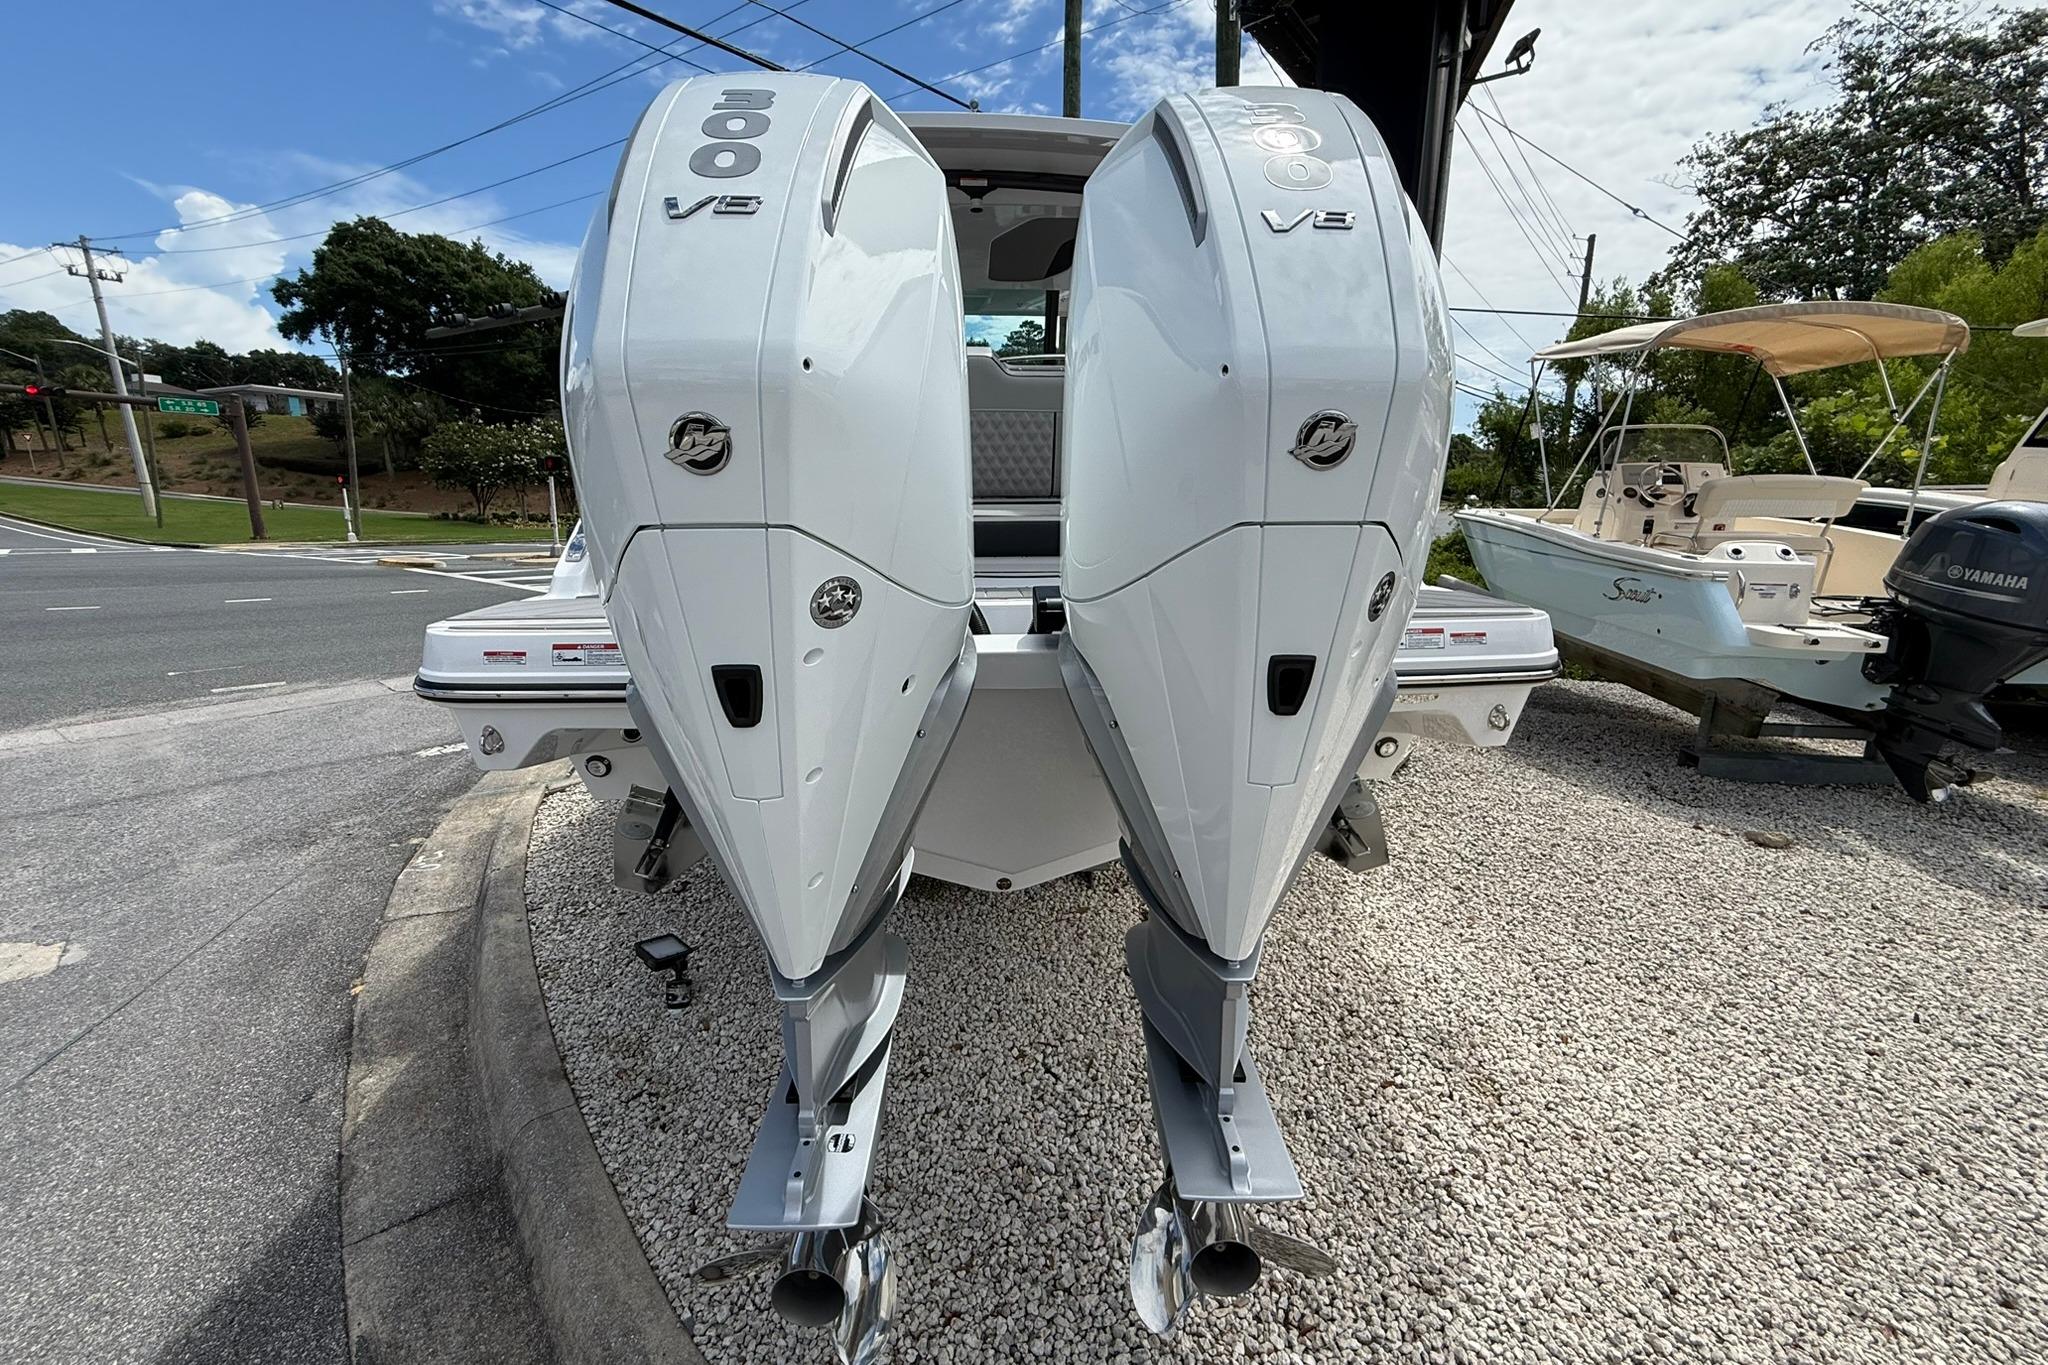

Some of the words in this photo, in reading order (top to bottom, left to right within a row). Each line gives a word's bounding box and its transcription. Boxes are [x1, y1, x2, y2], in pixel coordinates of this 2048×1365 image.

[689, 89, 777, 178] 300
[1243, 103, 1333, 191] 300
[664, 195, 764, 219] V6
[1261, 208, 1356, 233] V6
[1603, 577, 1657, 604] Scout
[1963, 567, 2029, 590] YAMAHA
